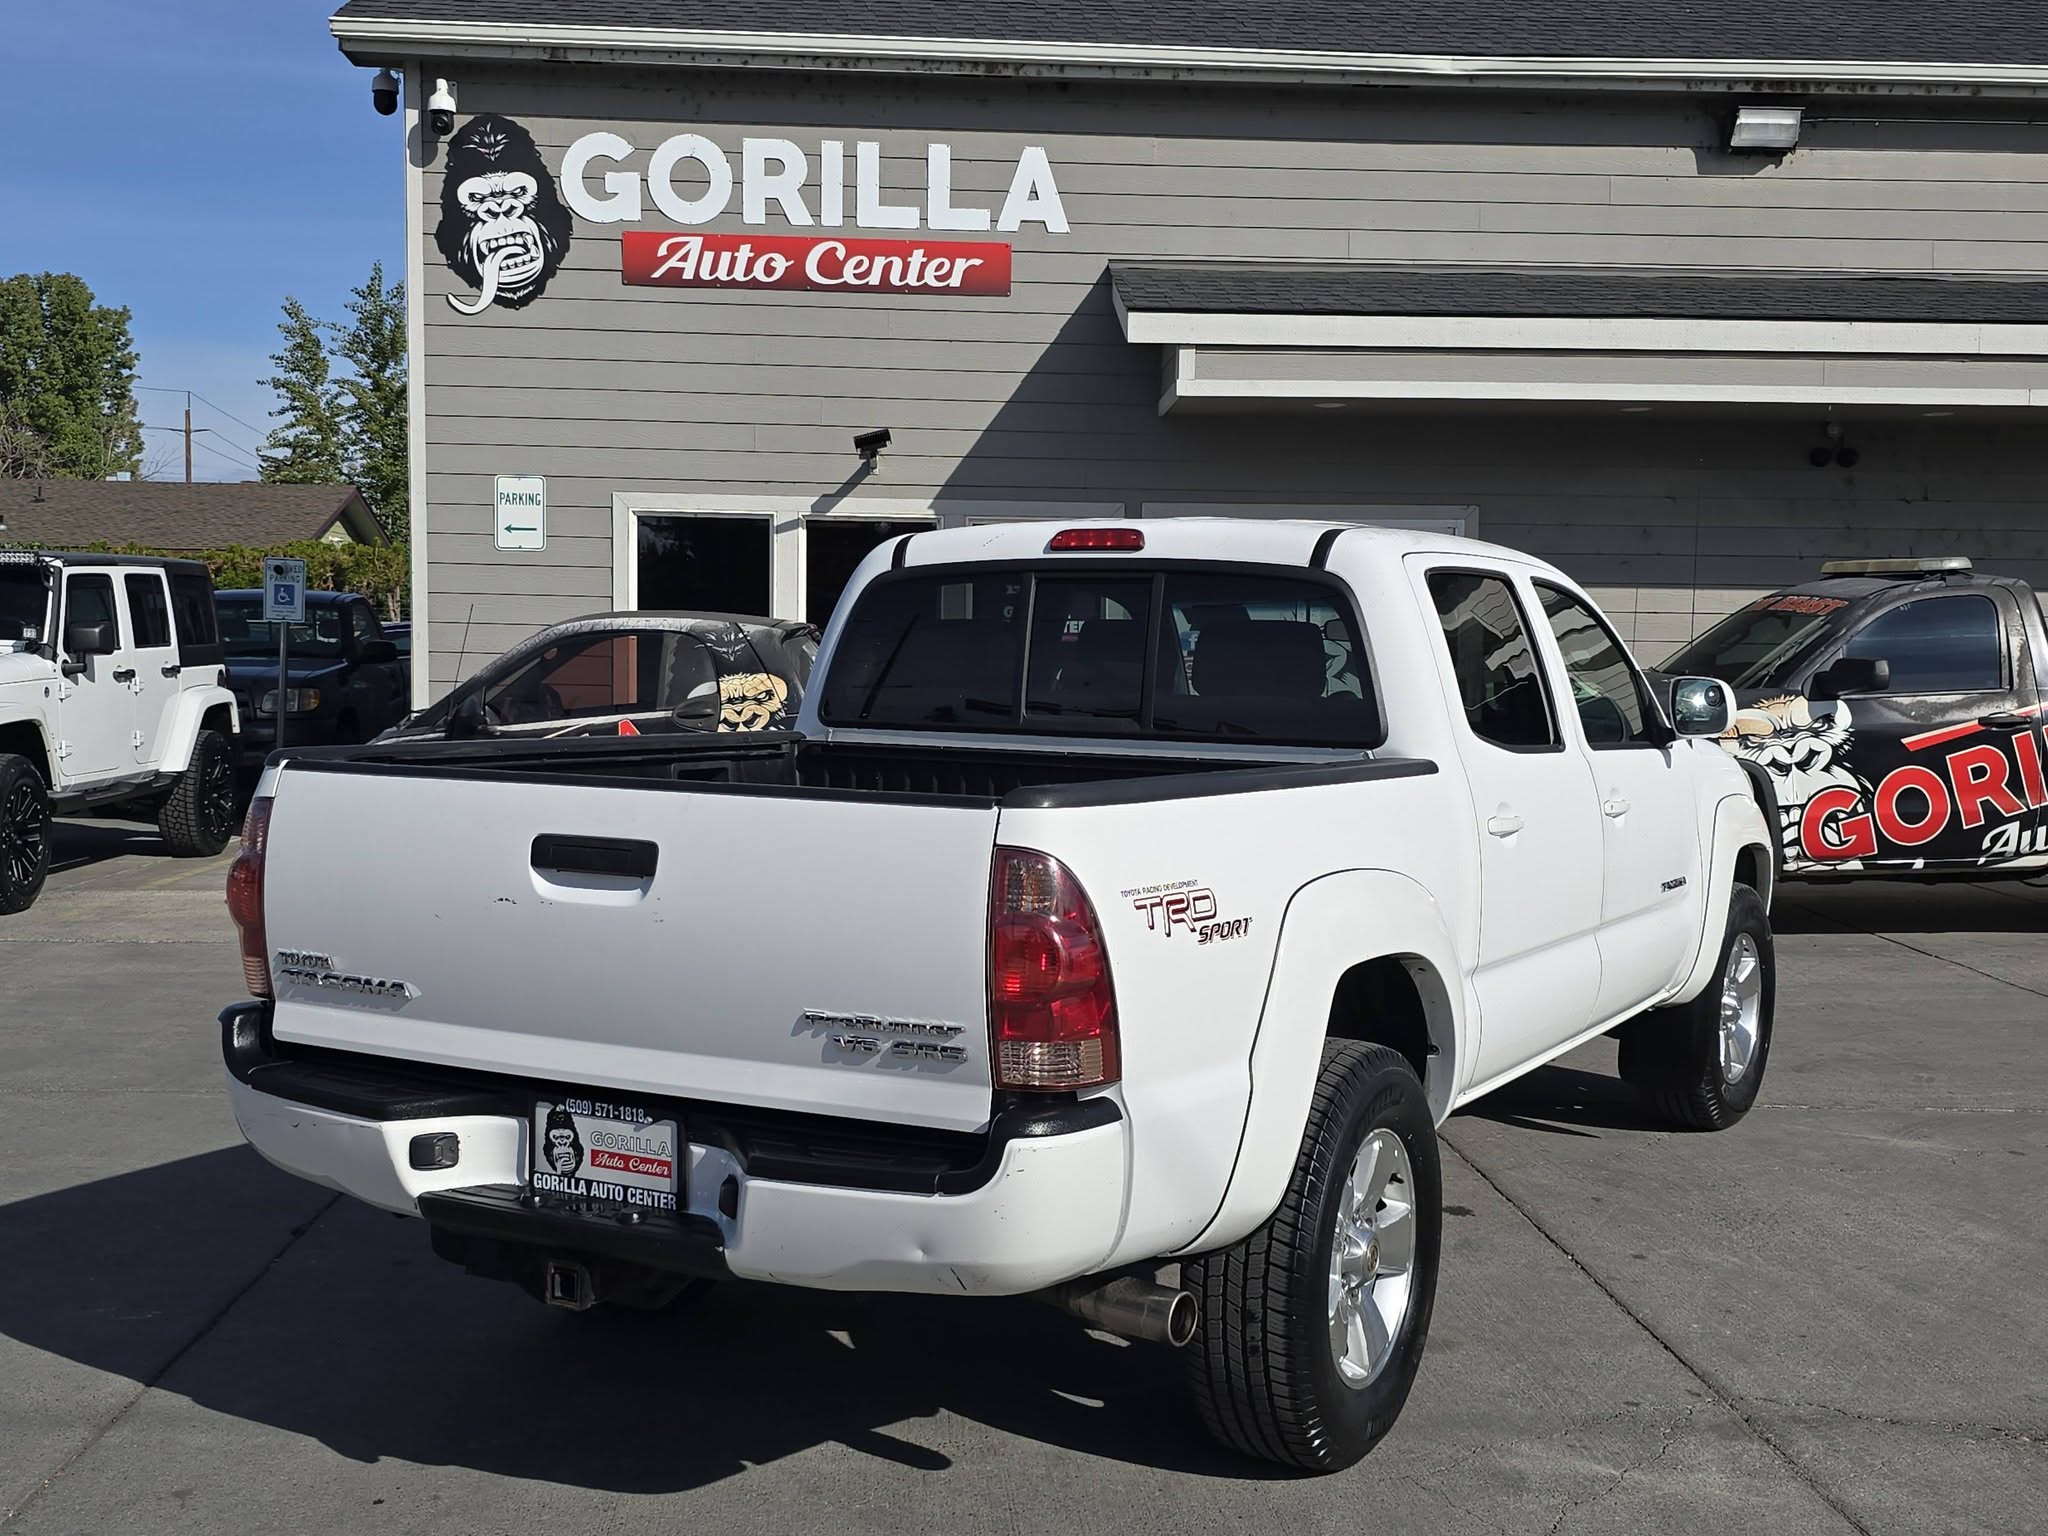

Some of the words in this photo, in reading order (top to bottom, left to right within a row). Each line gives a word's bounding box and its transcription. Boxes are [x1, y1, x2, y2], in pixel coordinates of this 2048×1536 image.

[560, 131, 1071, 234] GORILLA
[649, 236, 794, 283] Auto
[804, 240, 984, 288] Center
[499, 492, 542, 507] PARKING
[270, 575, 301, 584] PARKING
[1800, 725, 2048, 862] GORI
[1120, 890, 1142, 898] TOYOTA
[1142, 884, 1163, 894] RACING
[1163, 879, 1199, 891] DEVELOPMENT
[1133, 887, 1218, 937] TRD
[1198, 918, 1251, 945] SPORT
[566, 1098, 592, 1115] (509)
[594, 1103, 645, 1122] 571-1818
[590, 1130, 672, 1157] GORILLA
[594, 1152, 625, 1168] Auto
[628, 1158, 669, 1175] Center
[590, 1182, 623, 1201] AUTO
[627, 1188, 677, 1210] CENTER
